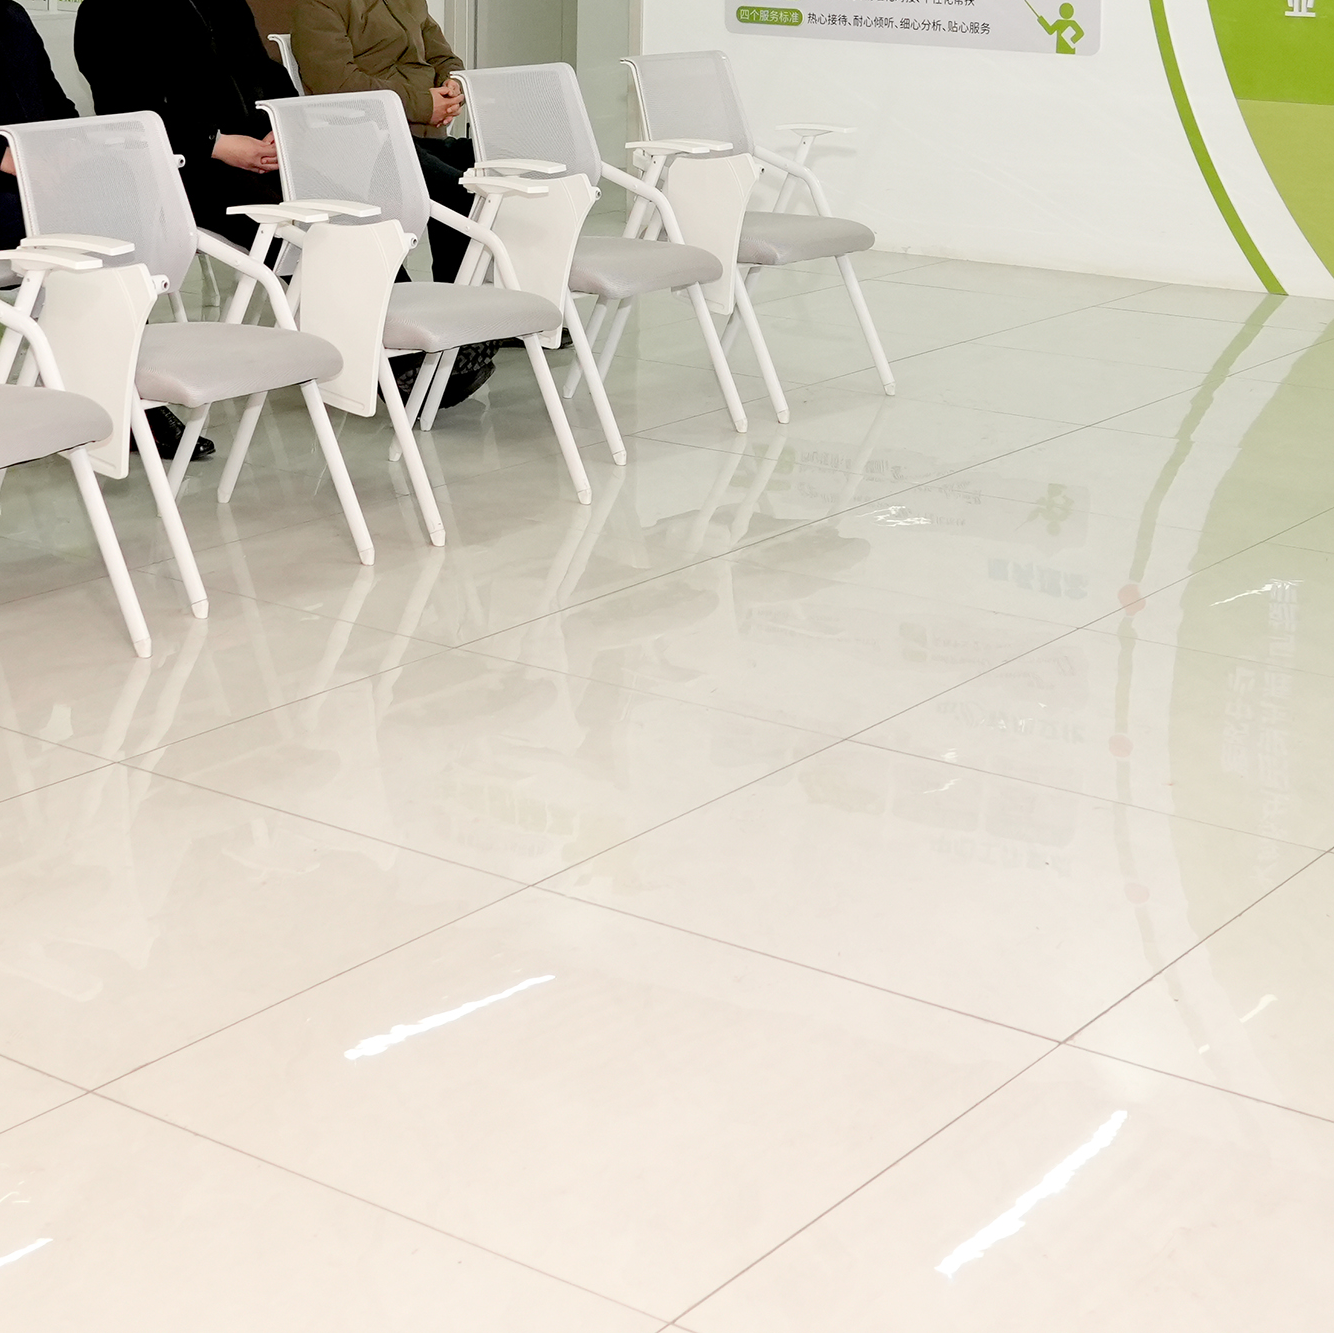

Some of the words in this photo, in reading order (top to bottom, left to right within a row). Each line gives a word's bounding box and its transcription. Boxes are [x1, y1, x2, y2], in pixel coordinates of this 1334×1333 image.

[740, 8, 799, 23] 四个服务标准
[807, 12, 990, 35] 热心接待、耐心倾听、细心分析、贴心服务
